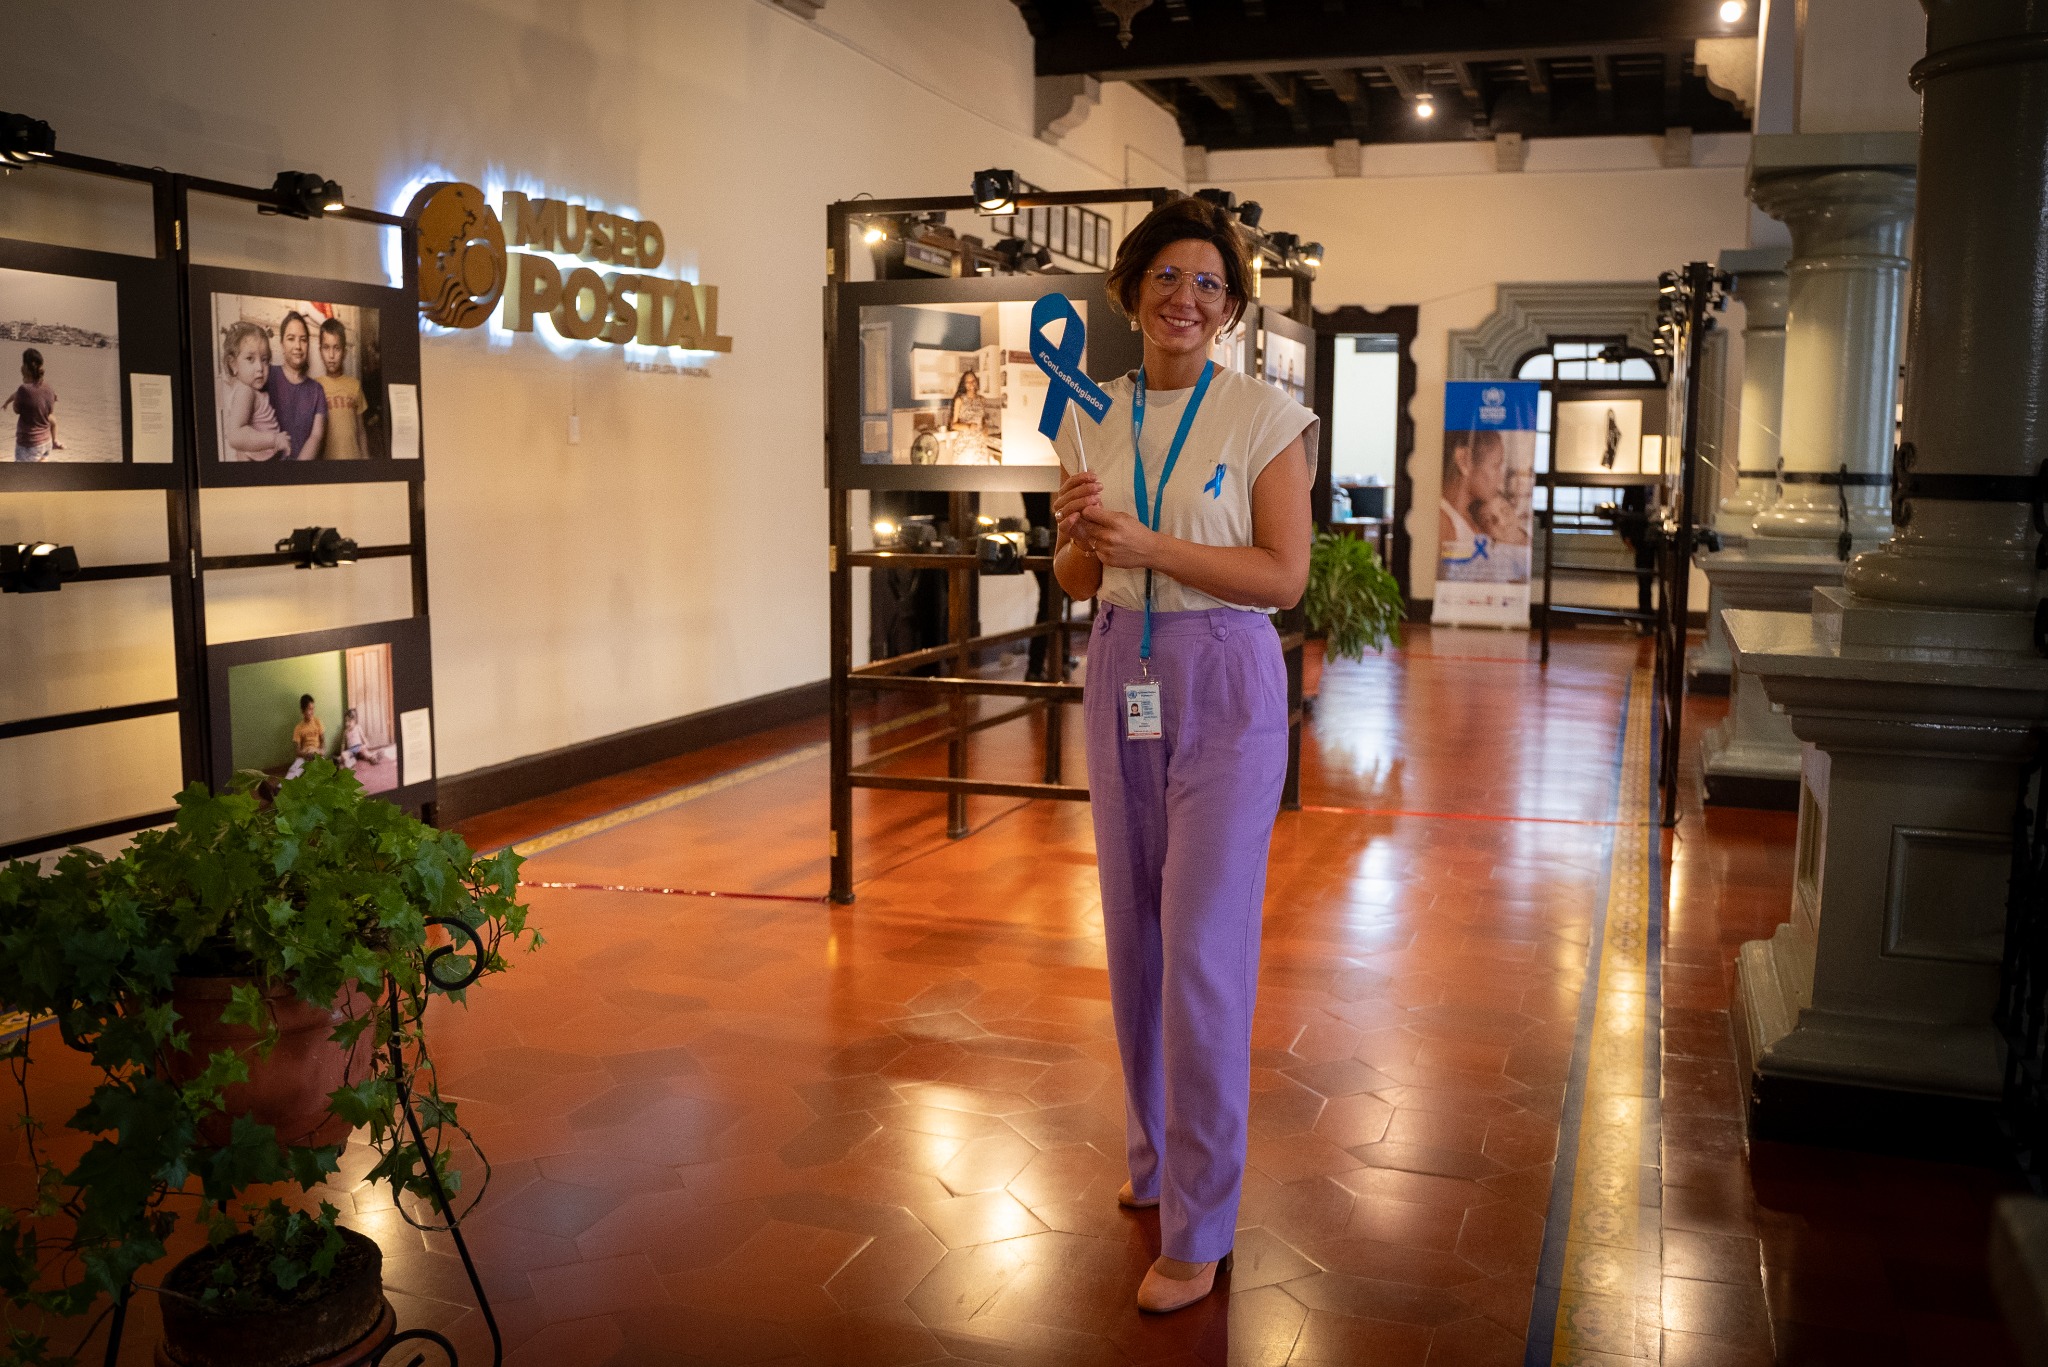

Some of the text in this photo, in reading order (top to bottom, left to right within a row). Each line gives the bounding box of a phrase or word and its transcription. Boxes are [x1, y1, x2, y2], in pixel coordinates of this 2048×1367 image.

[502, 191, 665, 269] MUSEO
[503, 252, 733, 353] POSTAL
[1039, 351, 1104, 411] #ConLosRefugiados
